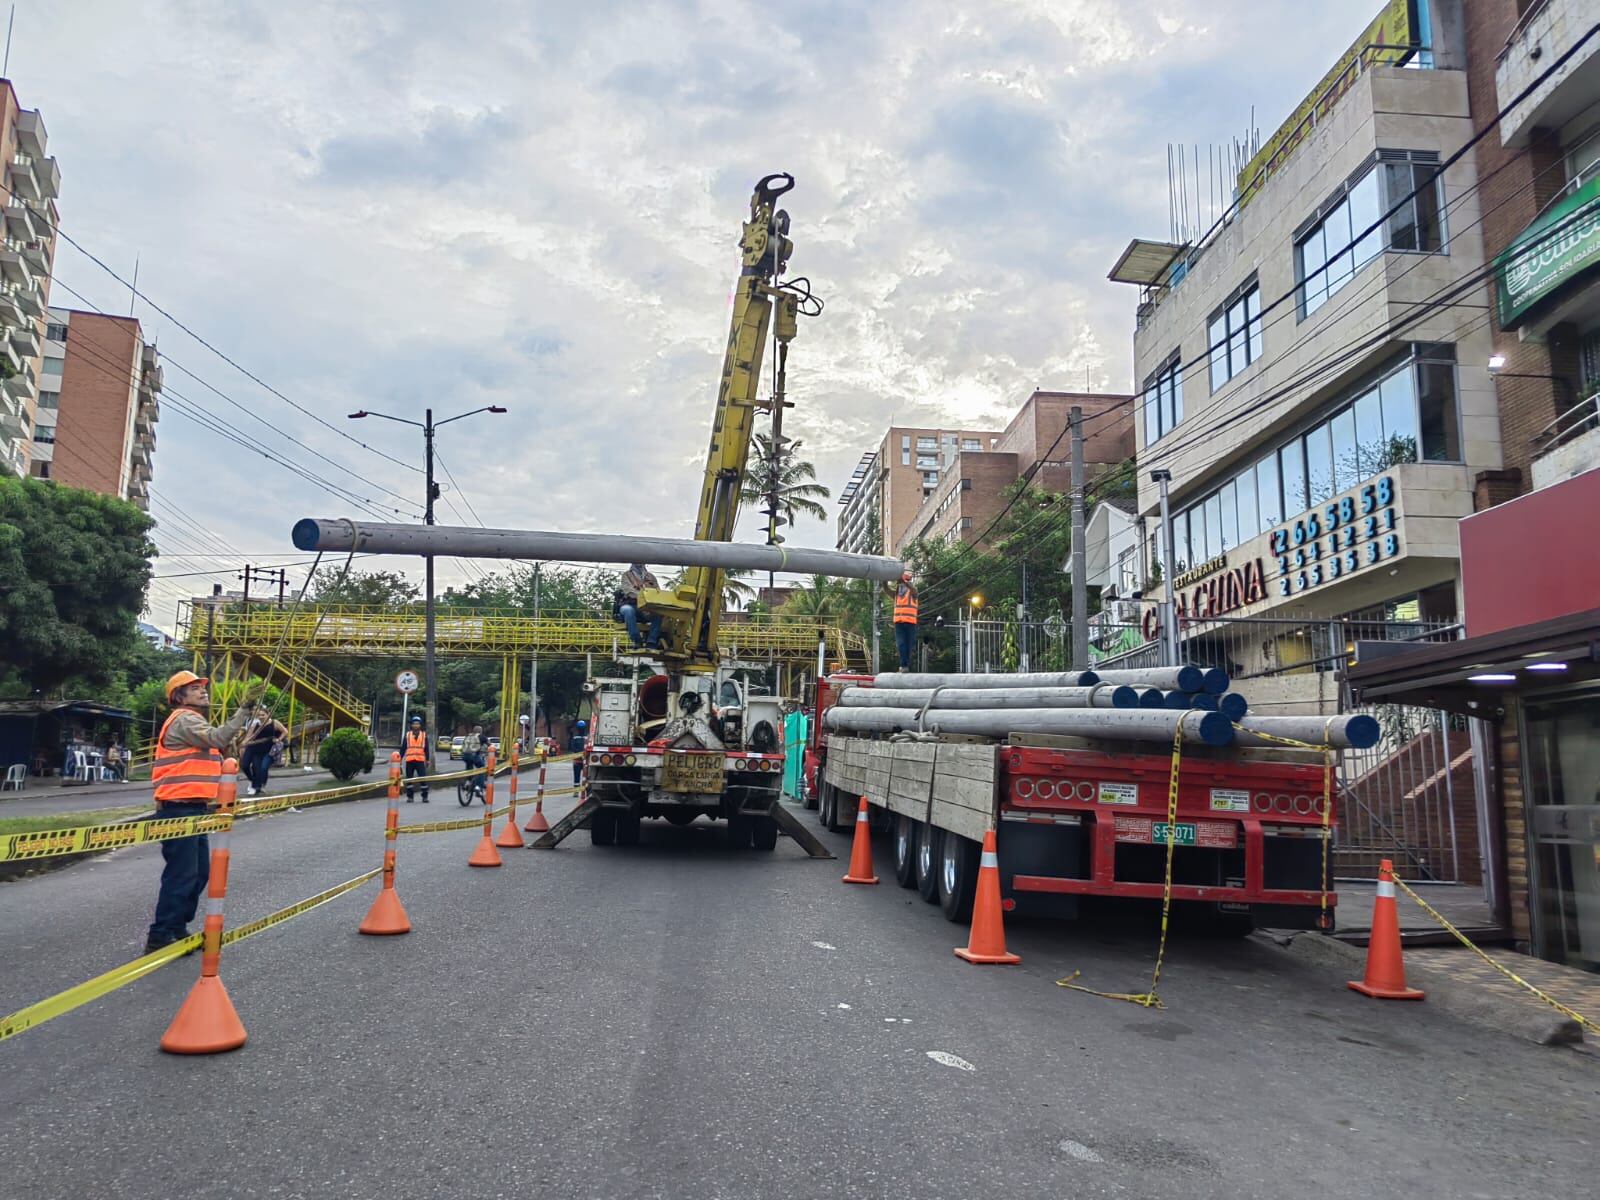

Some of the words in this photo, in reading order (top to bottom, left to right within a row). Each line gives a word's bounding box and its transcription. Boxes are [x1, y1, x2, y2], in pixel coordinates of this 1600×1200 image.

[709, 323, 741, 458] TEREX
[1173, 554, 1227, 591] ESTAURANTE
[1190, 557, 1269, 623] CHINA
[669, 754, 722, 769] PELIGRO
